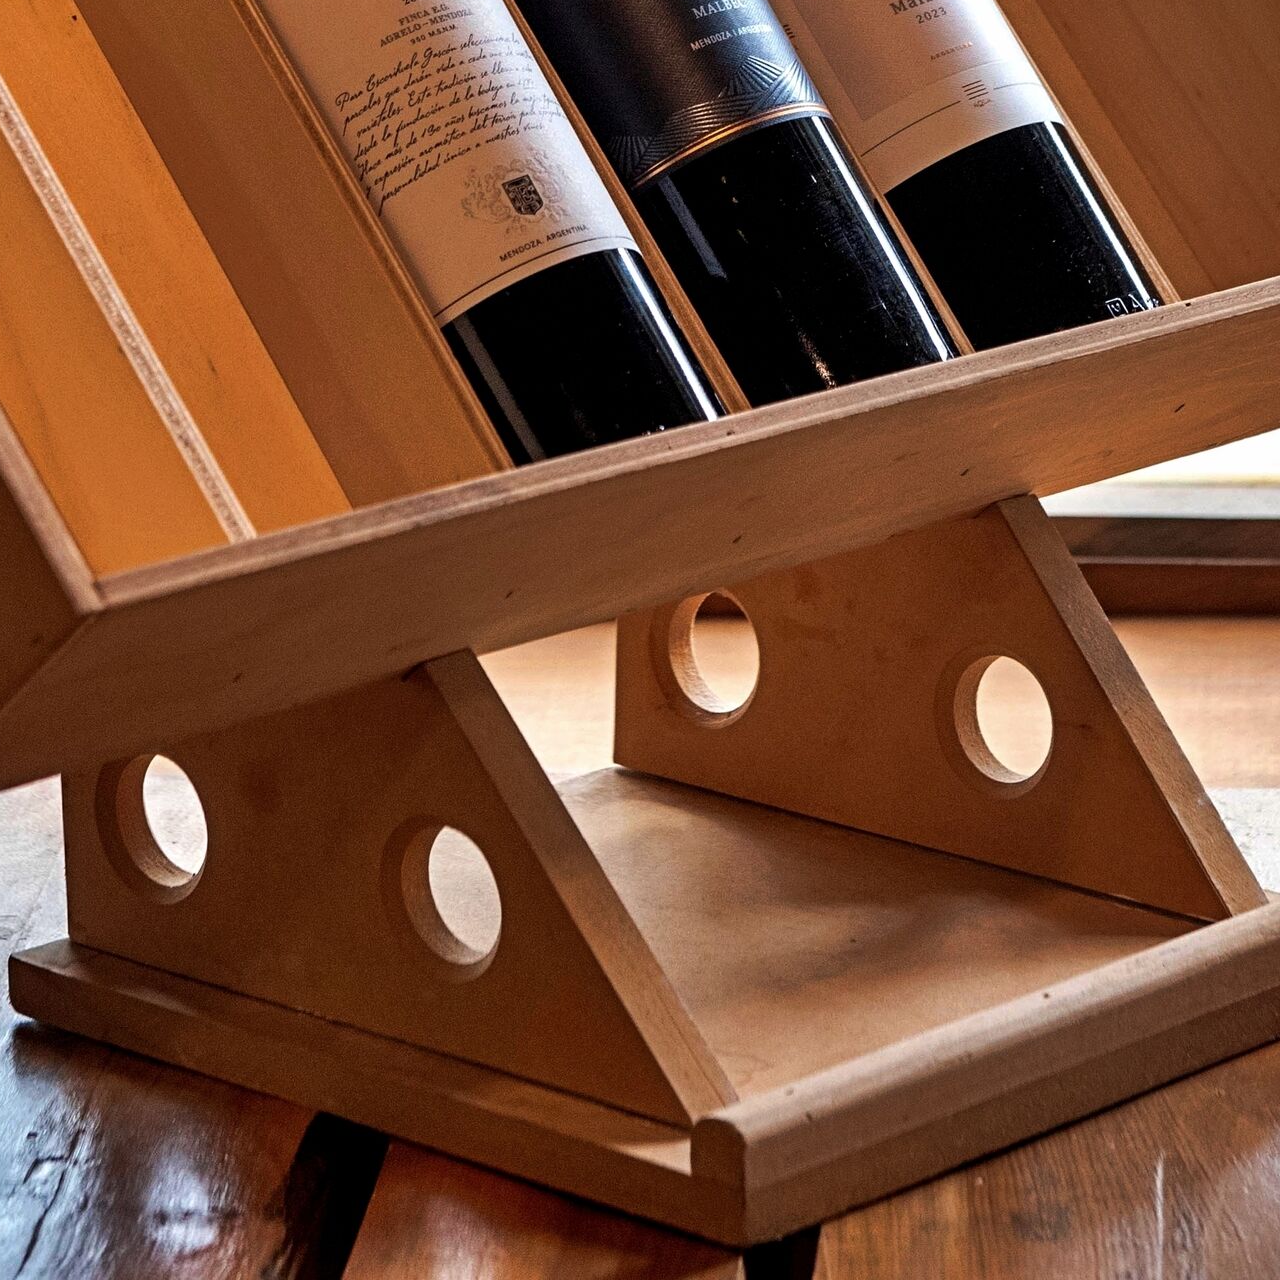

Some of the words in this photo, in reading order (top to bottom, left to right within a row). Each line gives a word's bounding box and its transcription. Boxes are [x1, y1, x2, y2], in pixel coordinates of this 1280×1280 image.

[398, 9, 430, 26] FINCA
[690, 29, 732, 52] MENDOZA
[916, 6, 948, 24] 2023
[335, 91, 363, 112] Para
[366, 52, 419, 92] Escorihuela
[421, 44, 457, 69] Gascón
[342, 92, 381, 136] parcelas
[380, 86, 401, 116] que
[403, 70, 432, 90] darán
[468, 48, 488, 63] cada
[408, 86, 432, 108] Esta
[434, 72, 477, 97] tradición
[480, 70, 488, 79] se
[354, 134, 378, 161] desde
[382, 124, 392, 142] la
[394, 104, 445, 148] fundación
[449, 91, 461, 107] de
[464, 85, 474, 100] la
[478, 80, 504, 101] bodega
[357, 159, 381, 182] Hace
[385, 143, 402, 160] más
[406, 131, 418, 149] de
[444, 114, 465, 128] años
[468, 101, 508, 118] buscamos
[510, 92, 520, 105] la
[374, 155, 416, 192] expresión
[419, 128, 466, 157] aromática
[470, 113, 490, 134] del
[378, 153, 440, 217] personalidad
[443, 147, 471, 164] única
[485, 124, 520, 144] nuestros
